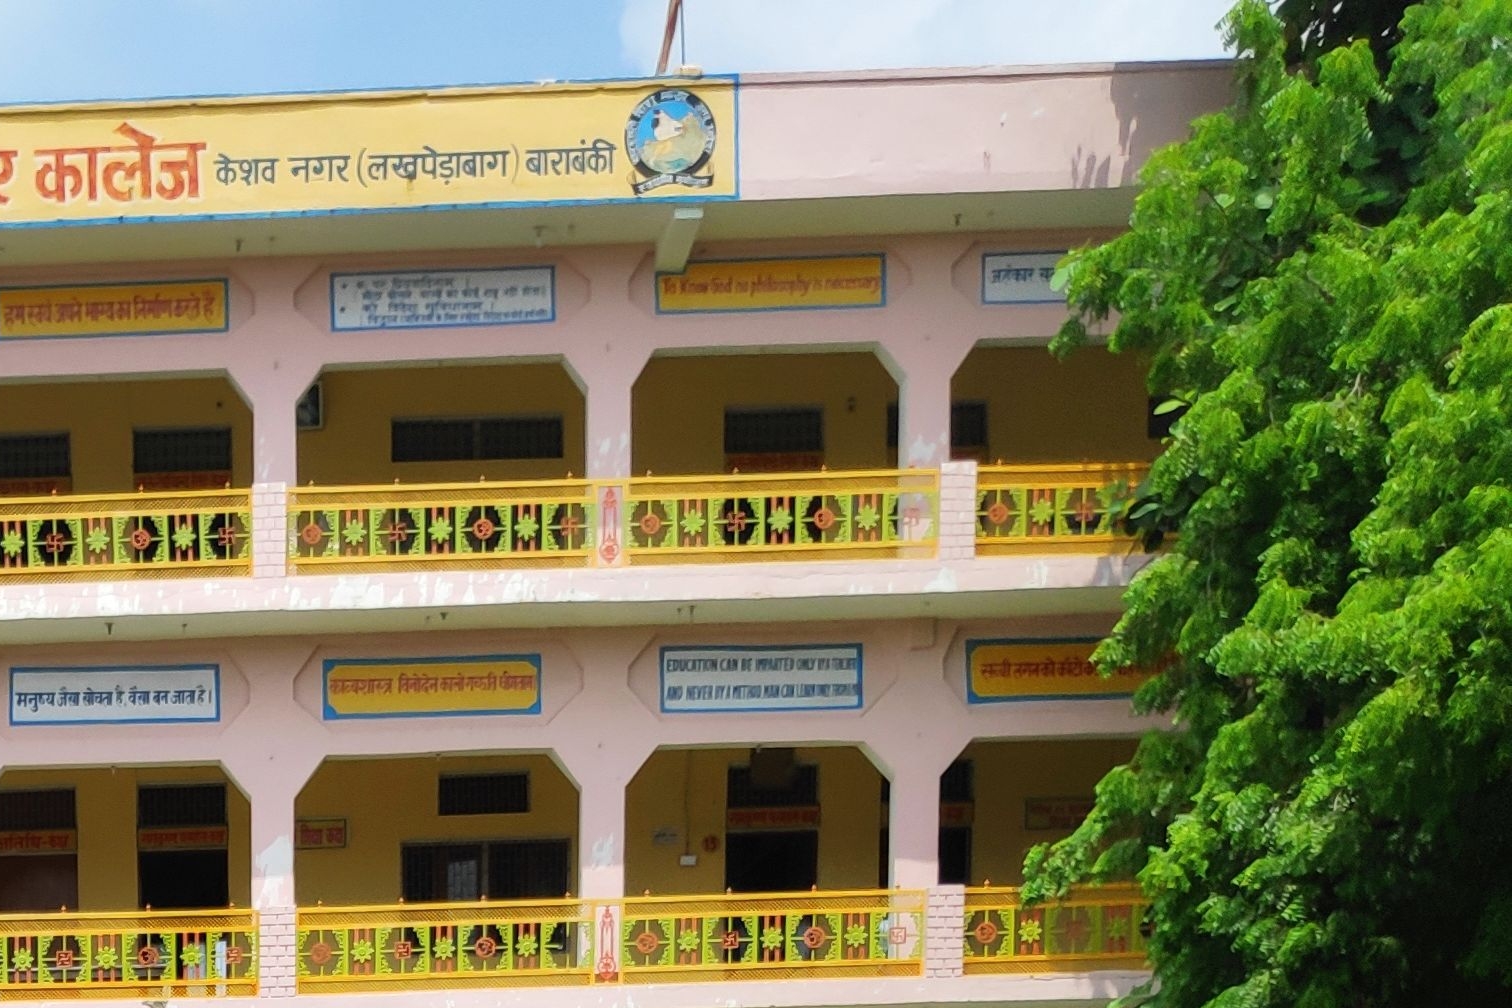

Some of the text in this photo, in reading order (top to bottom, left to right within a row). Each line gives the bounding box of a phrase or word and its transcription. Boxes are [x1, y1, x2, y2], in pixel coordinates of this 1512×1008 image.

[35, 121, 206, 202] कालेज
[214, 153, 278, 185] केशव
[290, 154, 351, 184] नगर
[526, 139, 617, 175] बाराबंकी
